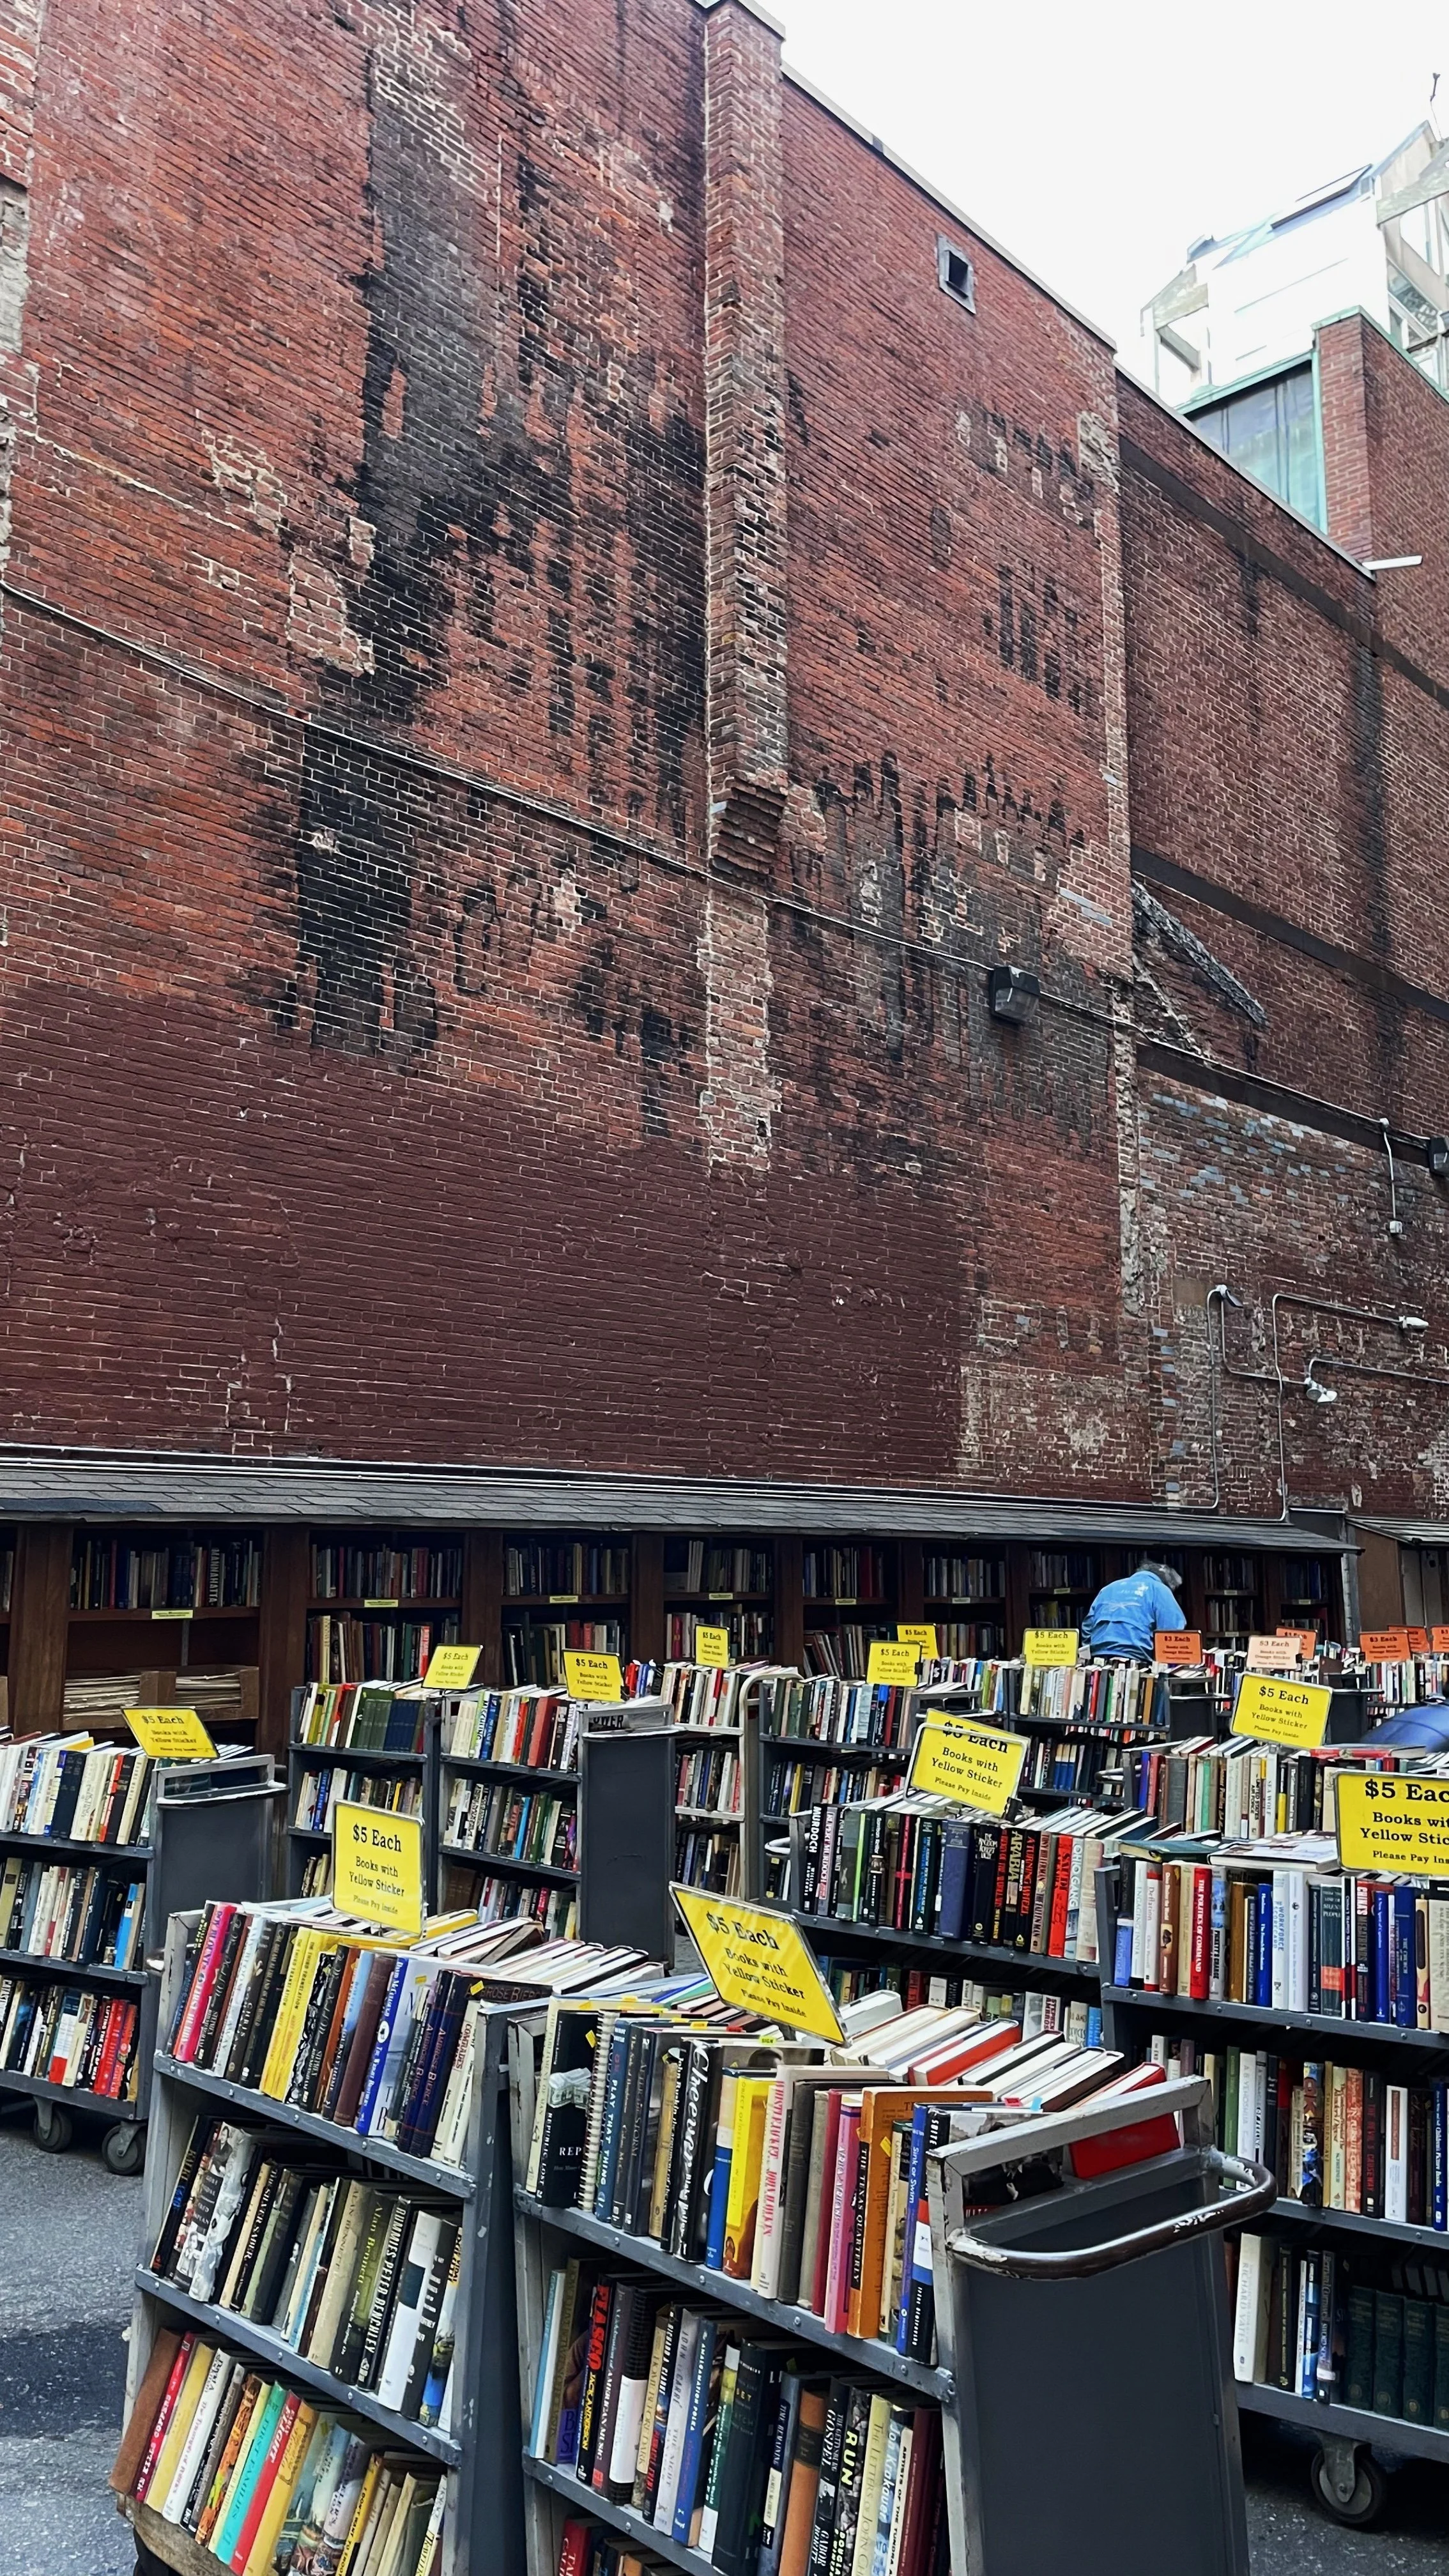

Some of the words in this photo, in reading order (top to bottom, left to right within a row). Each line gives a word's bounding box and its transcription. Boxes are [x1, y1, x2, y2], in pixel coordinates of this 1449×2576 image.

[209, 1549, 220, 1602] MANNAHATTA
[1034, 1631, 1045, 1639] $5
[576, 1658, 586, 1667] $5
[588, 1659, 608, 1669] Each
[1259, 1685, 1274, 1697] $5
[1278, 1690, 1308, 1705] Each
[1259, 1704, 1282, 1713] Books
[141, 1715, 155, 1724] $5
[157, 1715, 184, 1724] Each
[1252, 1712, 1276, 1722] Yellow
[1278, 1719, 1307, 1729] Sticker
[931, 1758, 964, 1775] Yellow
[967, 1769, 1003, 1788] Sticker
[942, 1747, 973, 1764] Books
[976, 1759, 998, 1772] with
[935, 1777, 955, 1789] Please
[958, 1784, 970, 1795] Pay
[1365, 1779, 1395, 1799] $5
[1406, 1783, 1449, 1802] Eac
[809, 1805, 822, 1853] MURDOCH
[824, 1813, 834, 1843] RUPERT
[1360, 1828, 1413, 1842] Yellow
[1373, 1812, 1421, 1825] Books
[353, 1823, 367, 1843] $5
[372, 1828, 402, 1852] Each
[356, 1855, 378, 1872] Books
[381, 1864, 399, 1877] with
[820, 1845, 830, 1885] MURDOCH
[1008, 1830, 1023, 1882] ARABIA
[1024, 1845, 1035, 1884] TURNING
[1071, 1844, 1082, 1873] OHIO
[1373, 1851, 1406, 1860] Please
[1411, 1853, 1429, 1864] Pay
[349, 1871, 374, 1888] Yellow
[376, 1879, 404, 1897] Sticker
[1069, 1873, 1080, 1907] GANG
[1356, 1887, 1368, 1915] CHINA'S
[706, 1911, 730, 1935] $5
[732, 1920, 780, 1951] Each
[1196, 1926, 1203, 1934] OF
[724, 1947, 758, 1967] Books
[761, 1961, 788, 1977] with
[282, 1968, 293, 2005] TRANSLATION
[294, 1971, 307, 2009] TRANSLATION
[723, 1962, 760, 1983] Yellow
[762, 1976, 806, 1999] Sticker
[741, 1988, 765, 2004] Please
[766, 1997, 781, 2011] Pay
[102, 2005, 110, 2029] LIFTING
[240, 2002, 253, 2037] CHRIS
[432, 2028, 447, 2071] AMBROSE
[456, 2024, 471, 2069] COMRADES
[423, 2073, 436, 2106] BIERCE
[683, 2041, 709, 2169] Cheever
[929, 2119, 939, 2145] SUITE
[601, 2149, 610, 2186] THING
[911, 2169, 916, 2179] or
[255, 2188, 272, 2224] SILVER
[369, 2202, 383, 2231] Alan
[334, 2220, 352, 2269] BENNETT
[356, 2234, 376, 2285] Bennett
[853, 2214, 864, 2283] QUARTERLY
[376, 2262, 394, 2296] PETER
[365, 2300, 385, 2354] BENCHLEY
[588, 2285, 610, 2371] FIASCO
[680, 2330, 689, 2360] JOHN
[649, 2353, 661, 2386] HOME
[693, 2342, 705, 2404] AMALGAMATION
[601, 2367, 613, 2425] AMERICAN
[581, 2400, 594, 2450] ANDERSON
[641, 2390, 656, 2436] BEFORE
[689, 2406, 698, 2432] POLKA
[142, 2442, 157, 2476] KILLS
[153, 2394, 171, 2438] COPPERS
[255, 2418, 269, 2456] FIRST
[270, 2406, 290, 2463] FLIGHT
[595, 2427, 605, 2460] MUSIC
[822, 2409, 836, 2466] GOSPEL
[874, 2423, 885, 2440] THE
[888, 2424, 900, 2441] Jon
[638, 2437, 648, 2465] DARK
[841, 2430, 858, 2485] RUN
[898, 2446, 907, 2485] ARTISTS
[232, 2459, 257, 2518] FAMILIES
[864, 2446, 881, 2498] LETTERS
[878, 2444, 898, 2524] Krakauer
[356, 2493, 365, 2515] DON'T
[898, 2490, 902, 2501] OF
[351, 2517, 359, 2537] WANT
[859, 2515, 873, 2549] JOHN
[346, 2540, 351, 2550] TO
[818, 2531, 829, 2566] GABOR
[890, 2527, 898, 2564] TUNDRA
